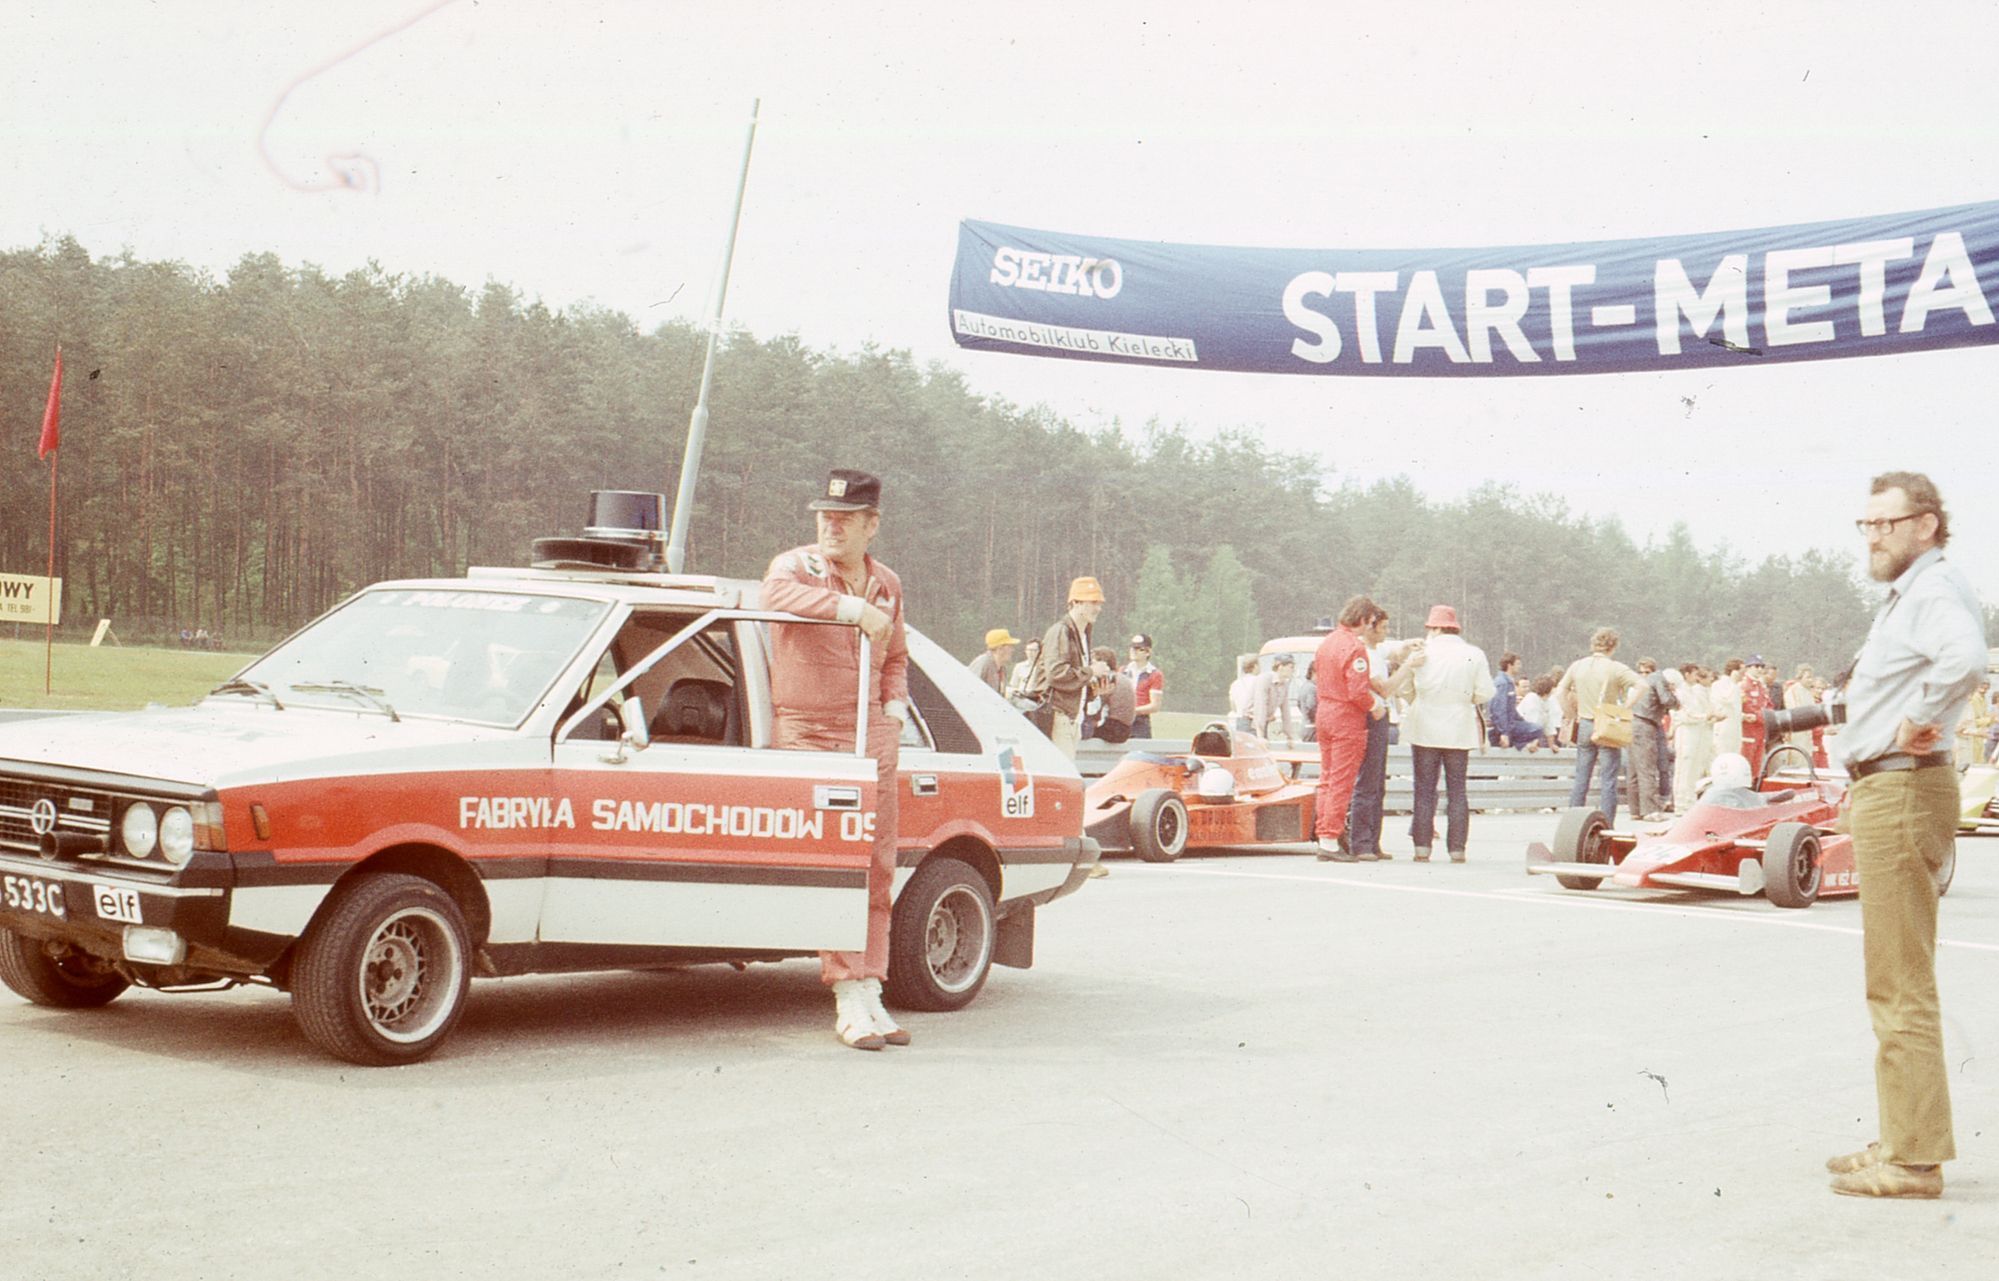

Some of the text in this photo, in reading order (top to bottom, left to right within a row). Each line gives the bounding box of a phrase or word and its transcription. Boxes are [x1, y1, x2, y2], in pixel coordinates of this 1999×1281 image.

[990, 246, 1123, 299] SEIKO
[1282, 231, 1997, 364] START-META
[957, 314, 1194, 360] Automobilklub Kielecki
[0, 581, 34, 599] WY
[1006, 795, 1028, 815] elf
[100, 892, 136, 920] elf
